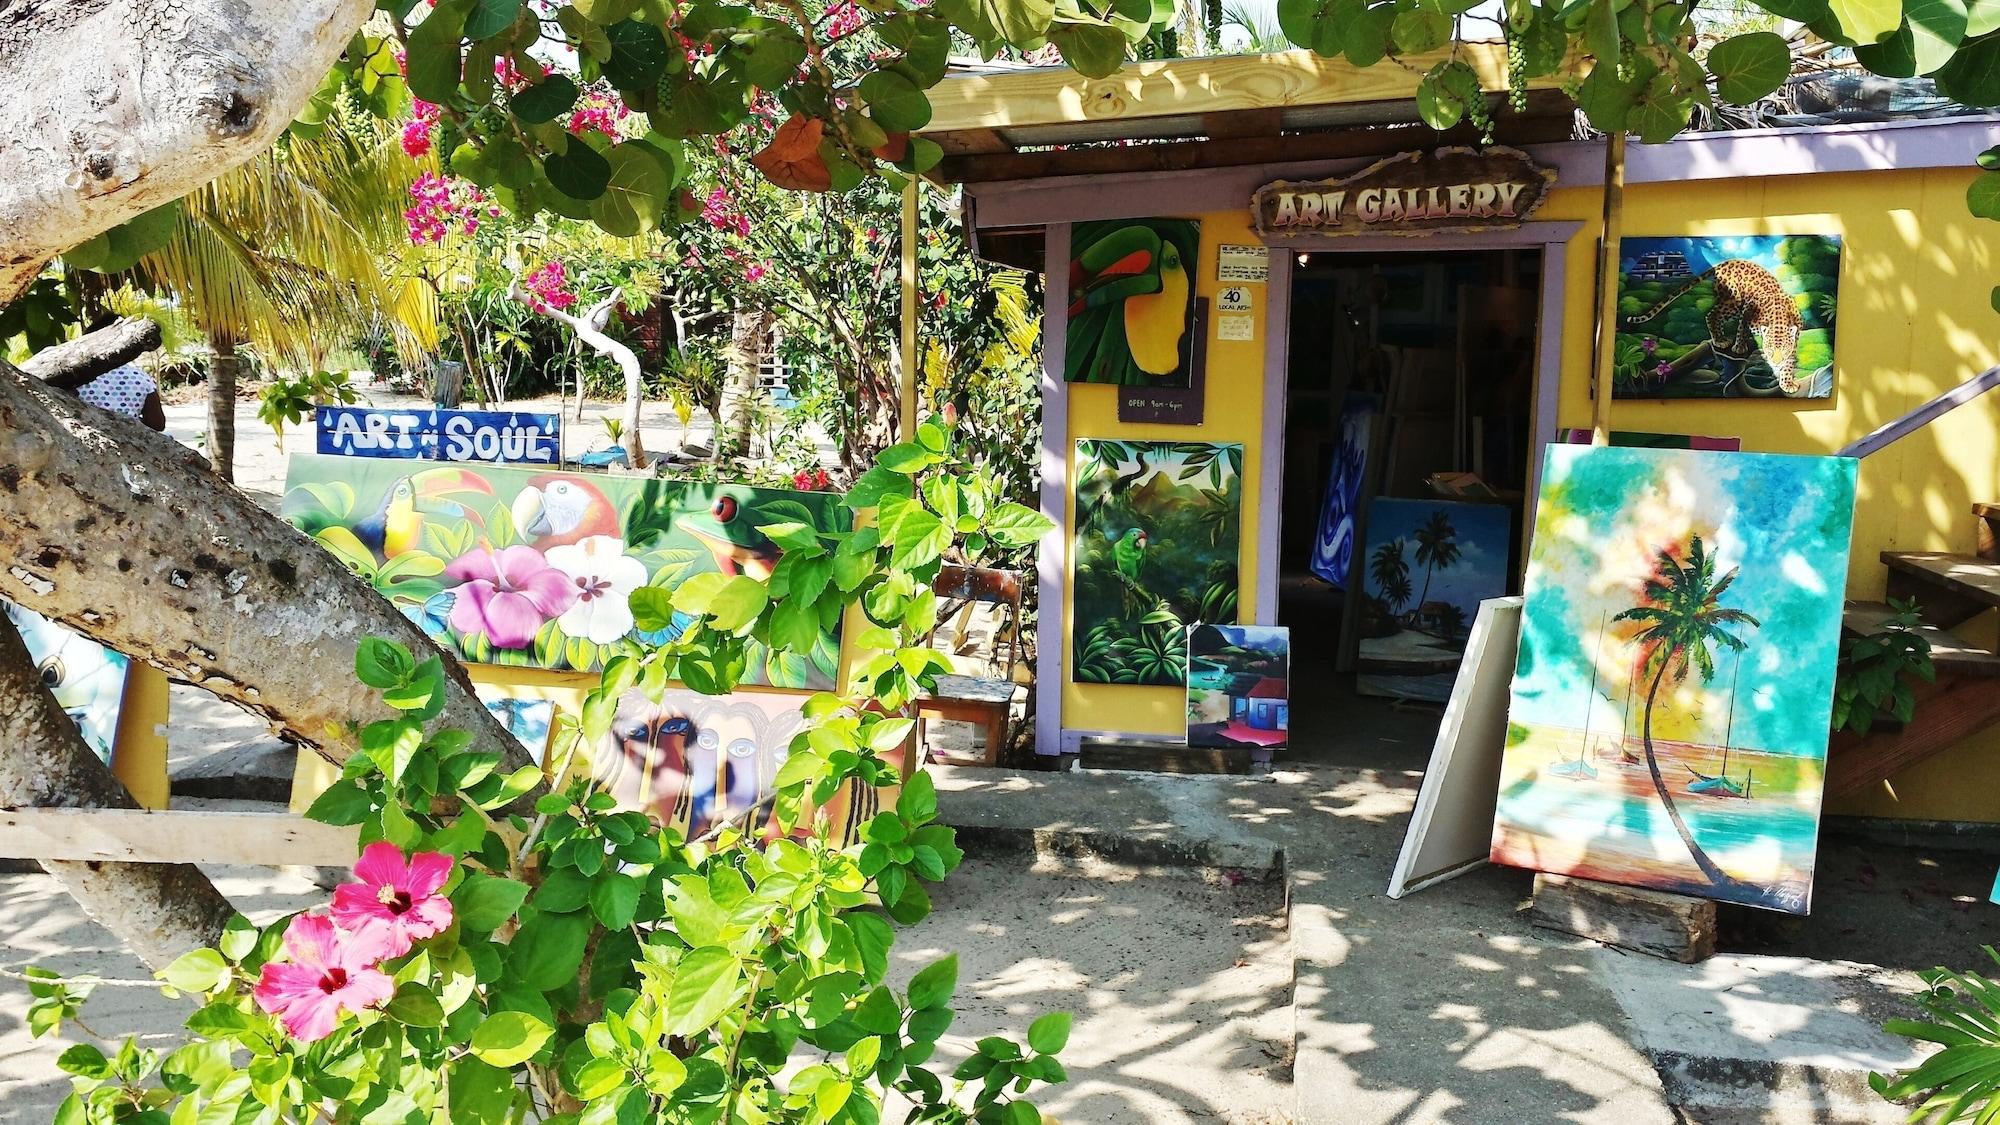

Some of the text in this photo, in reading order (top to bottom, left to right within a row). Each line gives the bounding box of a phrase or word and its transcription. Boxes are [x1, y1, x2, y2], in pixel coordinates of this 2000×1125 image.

[1273, 182, 1526, 227] ART GALLERY
[1224, 291, 1240, 303] 40
[1128, 399, 1145, 407] OPEN
[332, 412, 420, 450] ART
[445, 415, 551, 462] SOUL
